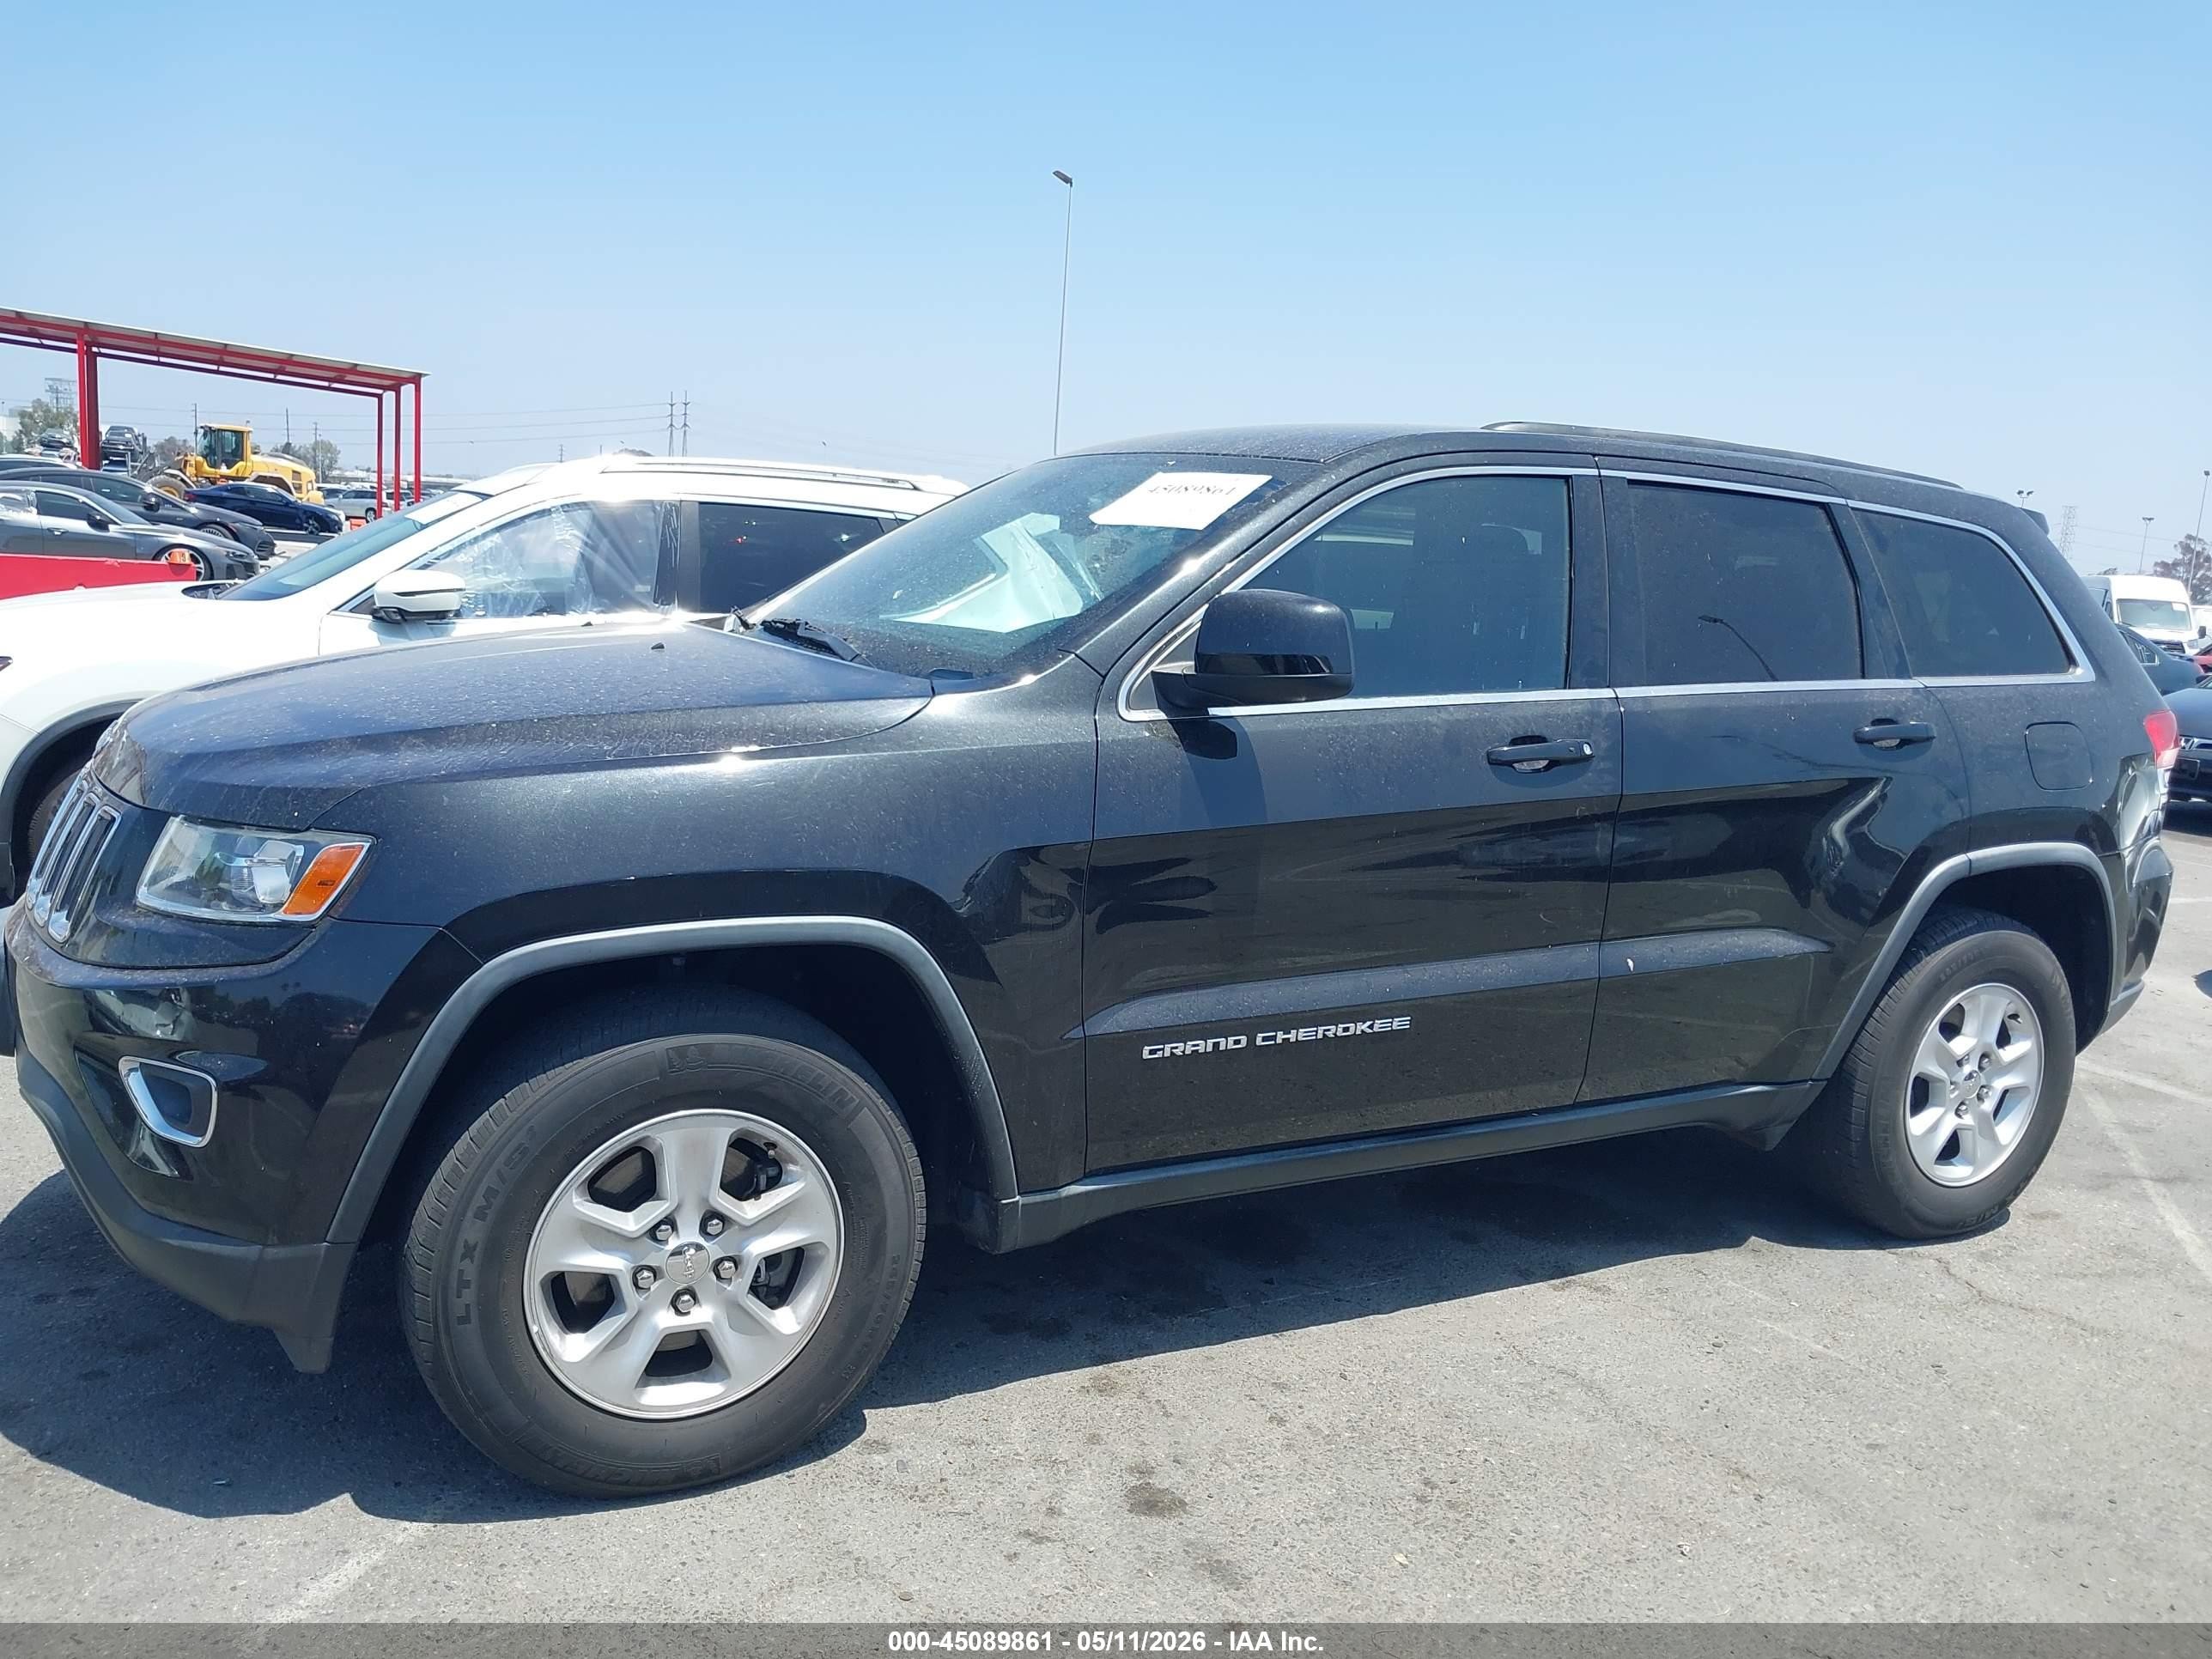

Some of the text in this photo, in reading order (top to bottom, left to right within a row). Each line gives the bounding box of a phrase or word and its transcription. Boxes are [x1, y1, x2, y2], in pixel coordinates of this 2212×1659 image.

[1142, 1016, 1412, 1060] GRAND CHEROKEE
[720, 1044, 860, 1109] CHELIN
[456, 1238, 478, 1326] LTX
